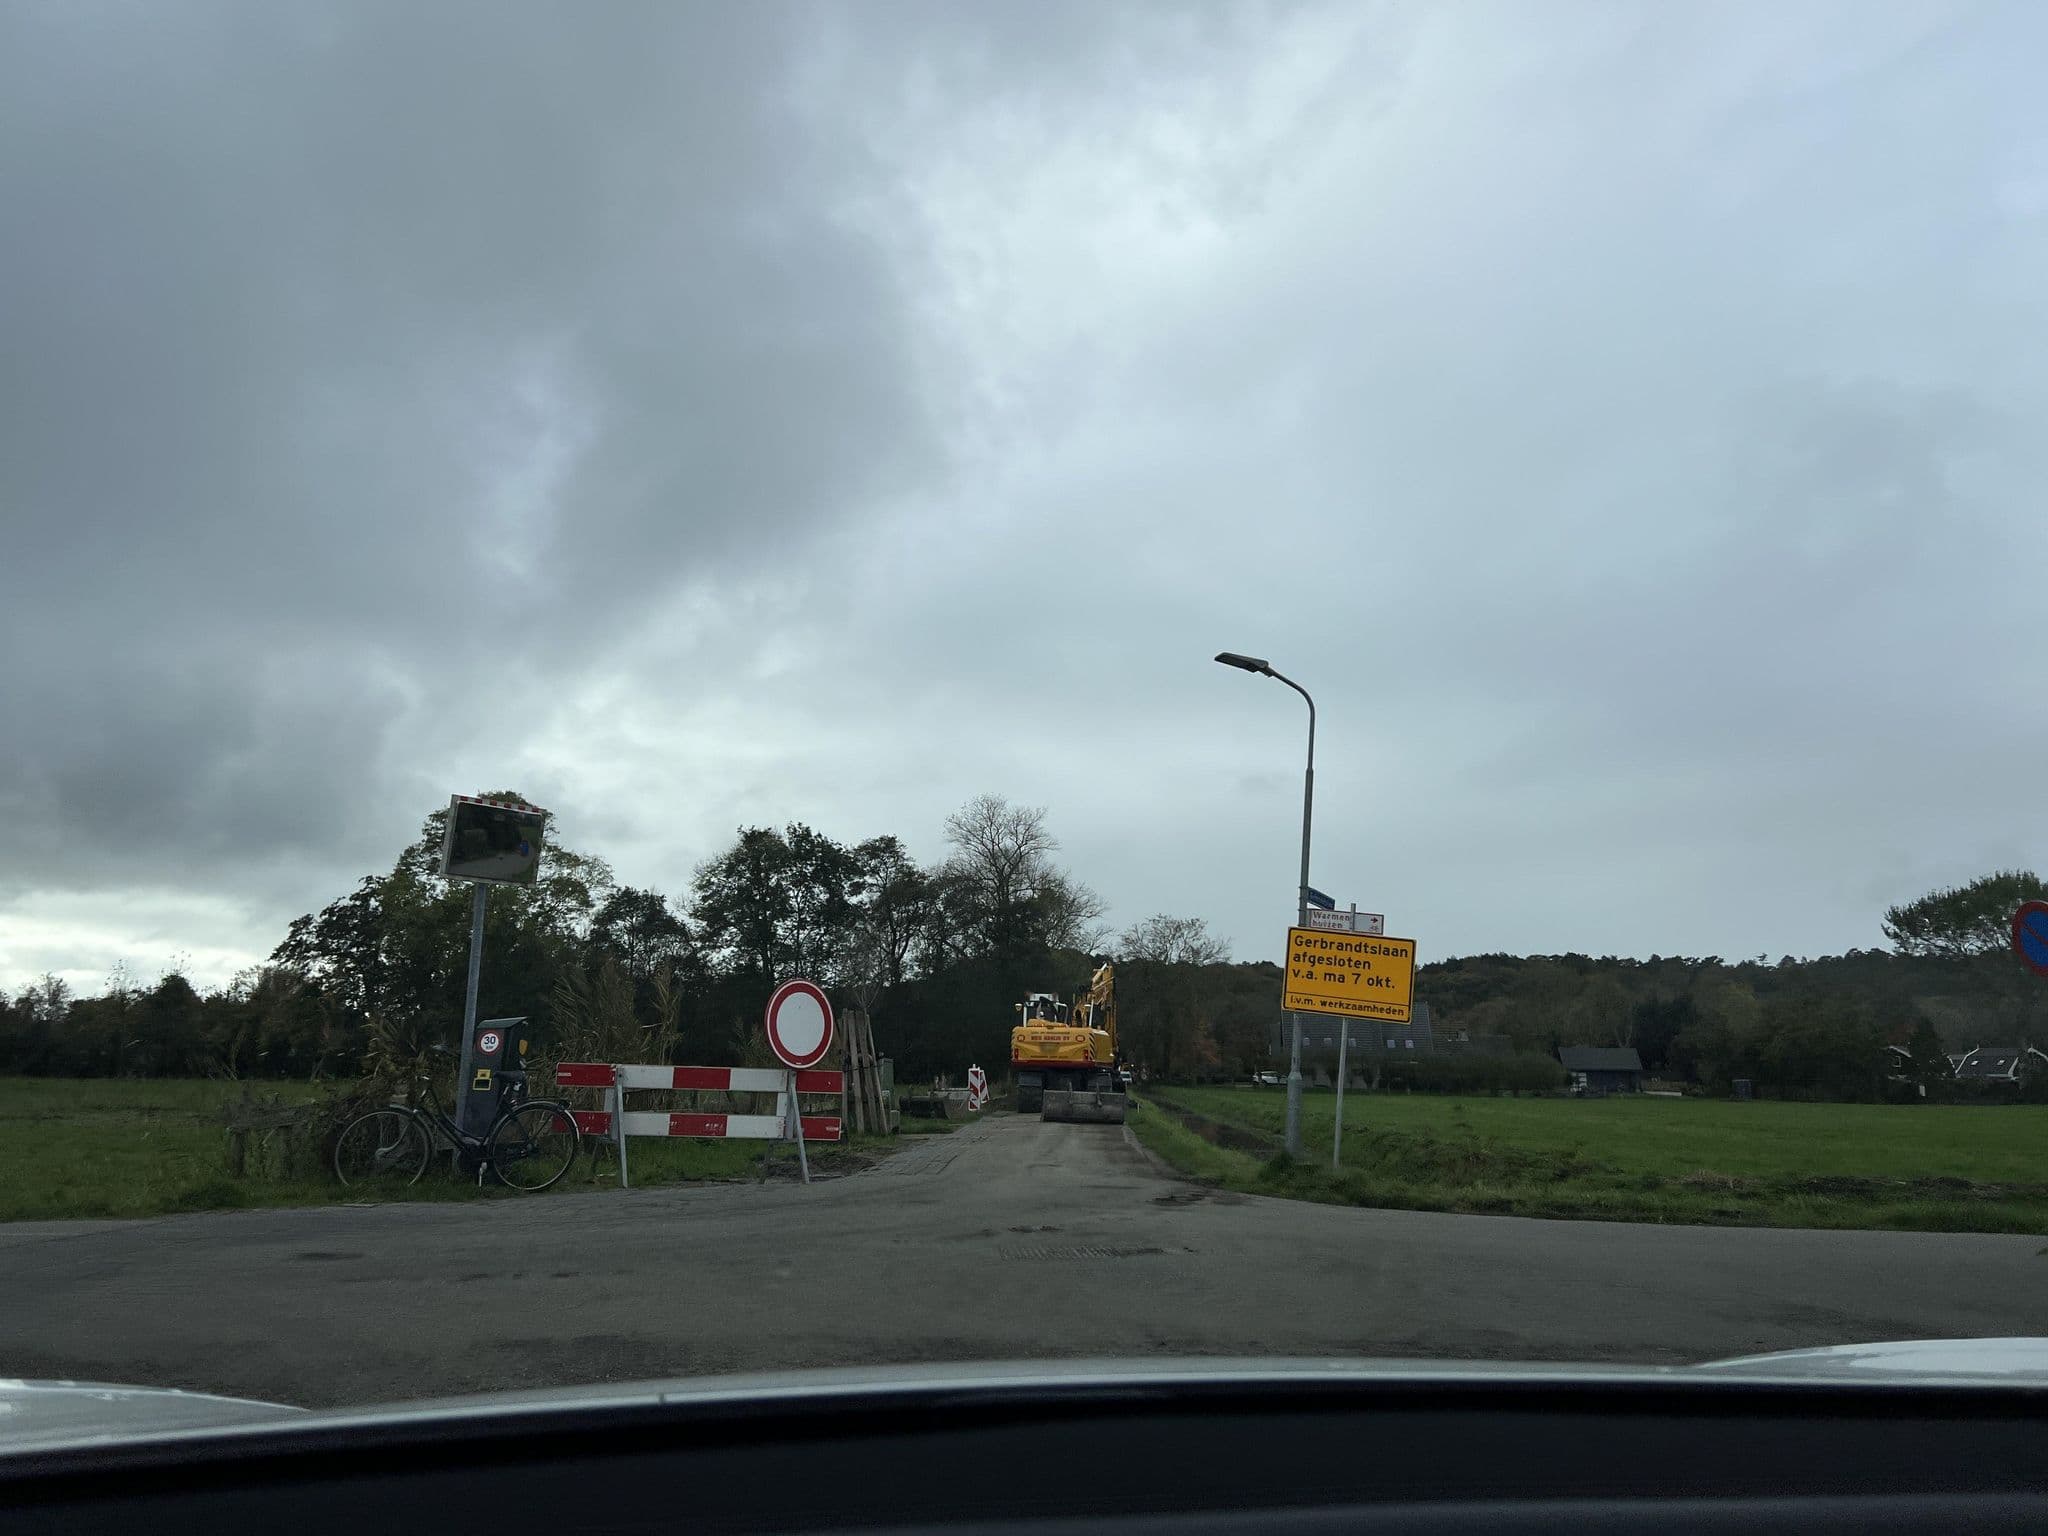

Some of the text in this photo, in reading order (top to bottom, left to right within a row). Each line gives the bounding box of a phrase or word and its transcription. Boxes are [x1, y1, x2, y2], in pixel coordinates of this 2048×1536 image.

[1313, 911, 1350, 921] Warmen
[1294, 935, 1408, 958] Gerbrandtslaan
[1293, 951, 1371, 970] afgesloten
[1292, 968, 1395, 989] v.a. ma 7 okt.
[1320, 1000, 1404, 1016] werkzaamheden
[484, 1036, 496, 1044] 30
